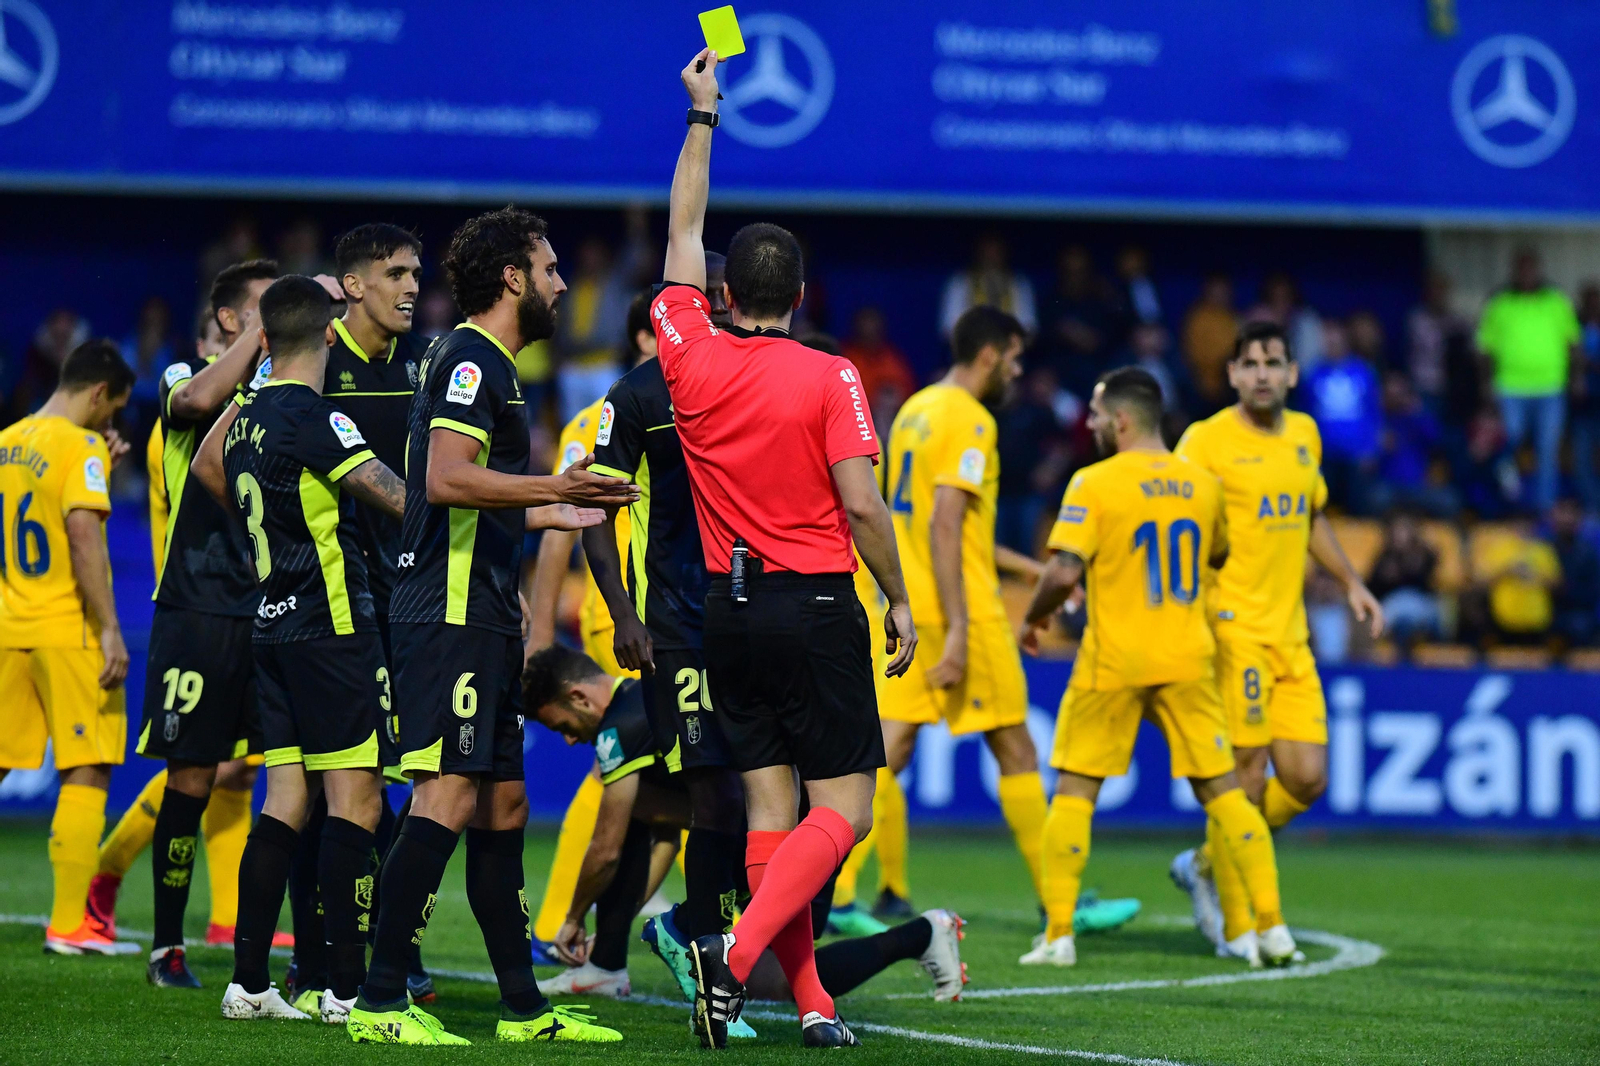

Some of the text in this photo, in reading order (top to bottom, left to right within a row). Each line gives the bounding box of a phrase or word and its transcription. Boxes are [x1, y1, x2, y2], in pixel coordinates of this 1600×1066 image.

[450, 389, 473, 400] LaLiga
[250, 423, 266, 454] M.
[1140, 478, 1193, 500] NONO
[235, 471, 272, 583] 3
[1133, 519, 1200, 607] 10
[162, 667, 204, 715] 19
[375, 666, 392, 712] 3
[452, 672, 478, 719] 6
[1244, 667, 1260, 700] 8
[373, 1024, 401, 1045] adida
